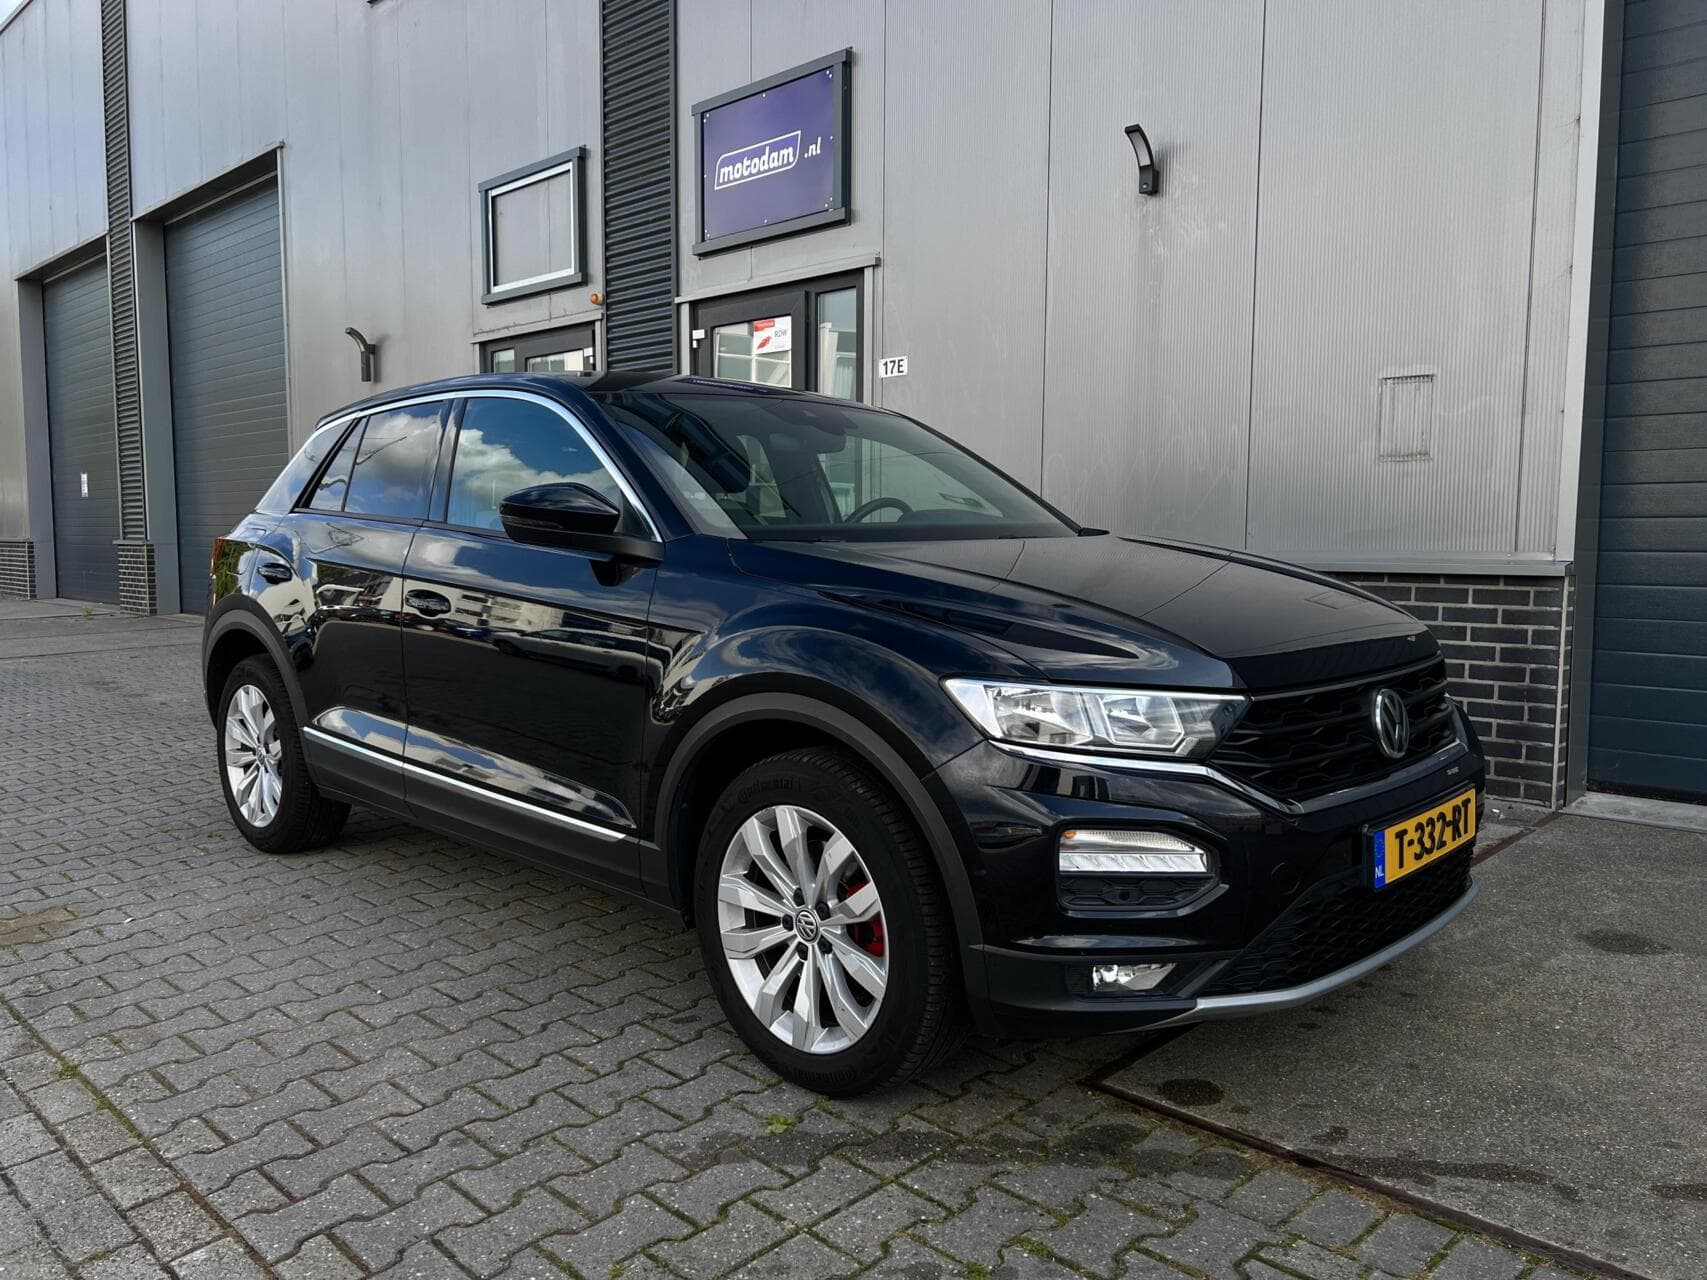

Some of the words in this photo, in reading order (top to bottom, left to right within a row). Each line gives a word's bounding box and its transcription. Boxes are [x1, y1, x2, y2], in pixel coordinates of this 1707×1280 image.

[719, 146, 794, 183] motodam
[804, 137, 821, 158] .nl
[882, 358, 905, 376] 17E
[1395, 797, 1471, 869] T-332-RT
[1375, 865, 1385, 879] NL
